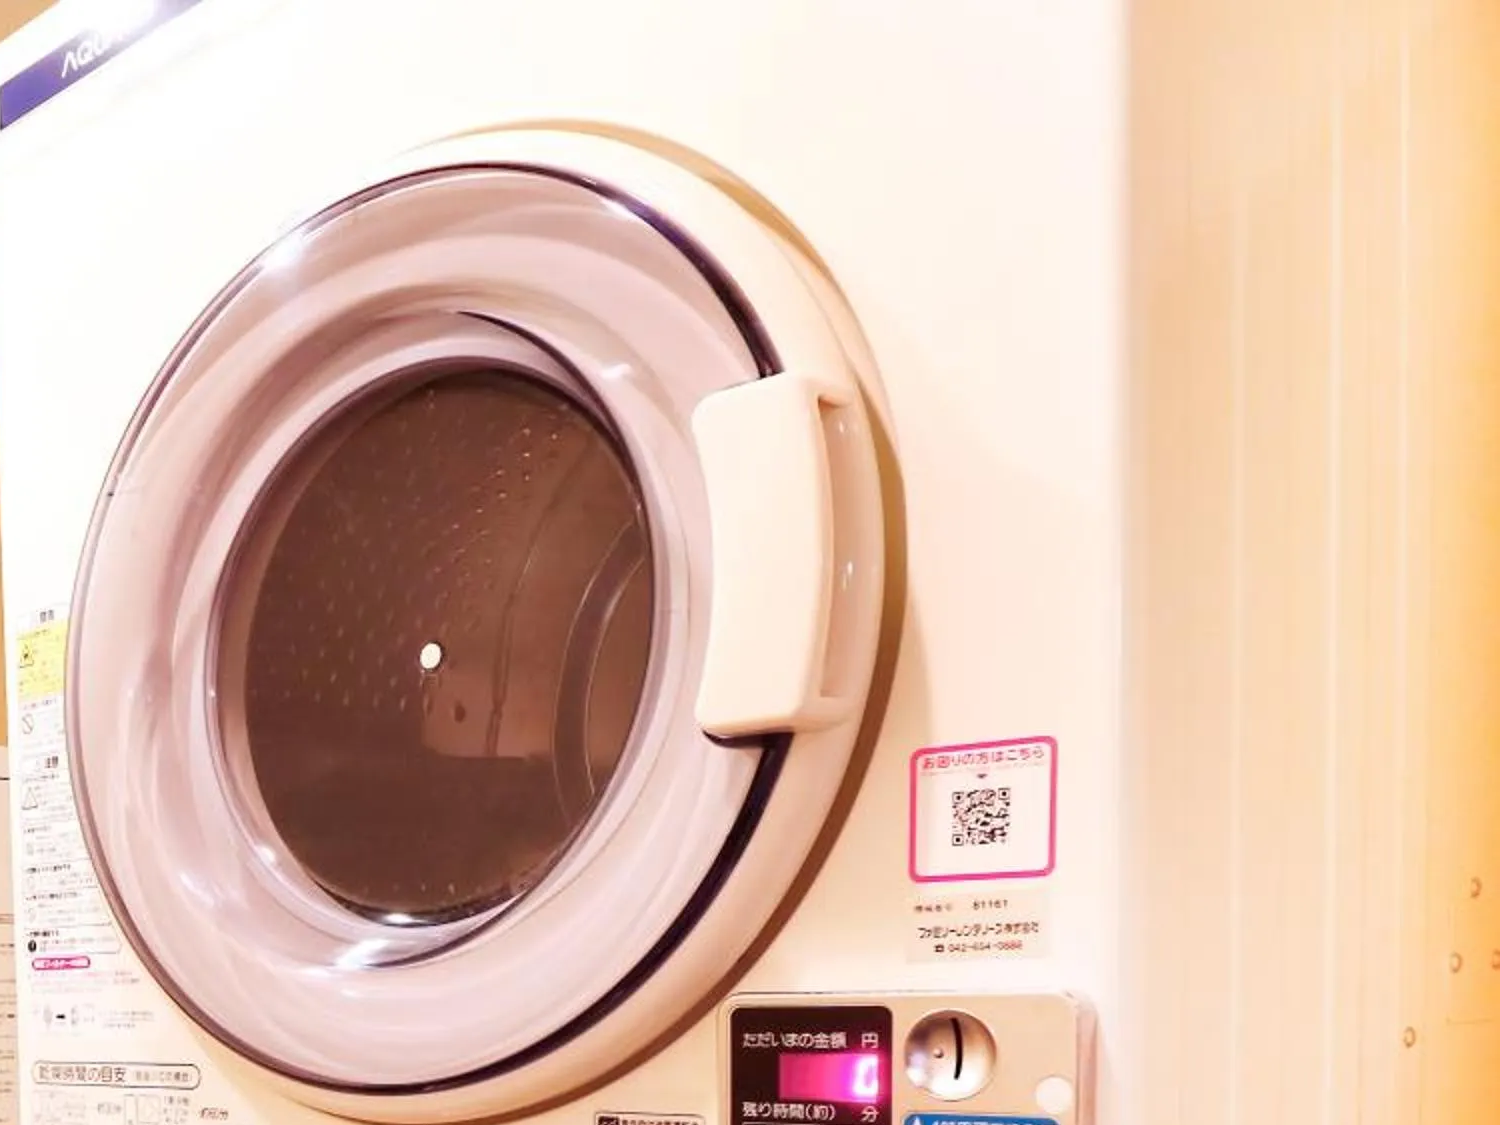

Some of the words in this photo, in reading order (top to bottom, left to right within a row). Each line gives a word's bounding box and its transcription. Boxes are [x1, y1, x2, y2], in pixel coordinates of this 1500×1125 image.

[922, 746, 1044, 770] お困りの方はこちら
[742, 1031, 848, 1049] ただいまの金額
[861, 1032, 878, 1049] 円
[861, 1106, 879, 1122] 分
